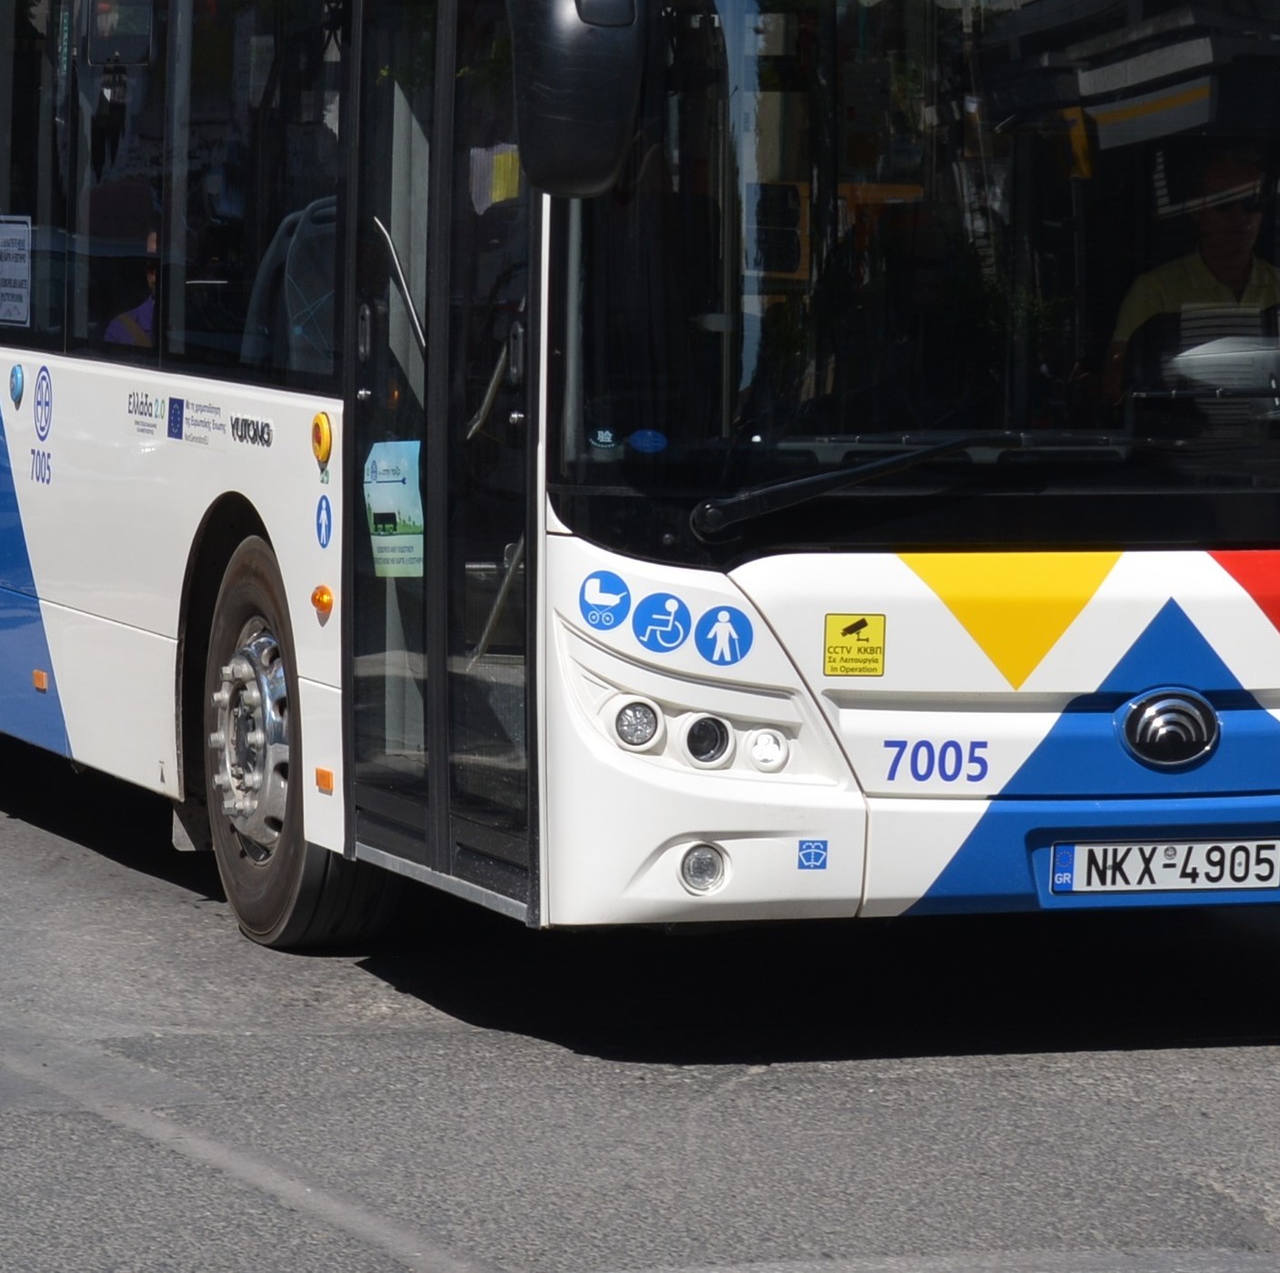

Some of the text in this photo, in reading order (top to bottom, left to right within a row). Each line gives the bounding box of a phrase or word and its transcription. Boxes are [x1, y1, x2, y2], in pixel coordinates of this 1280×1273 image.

[128, 391, 165, 419] Ελλάδα 2.0
[230, 415, 274, 448] YUTONG
[30, 448, 52, 486] 7005
[827, 646, 853, 655] CCTV
[828, 656, 837, 664] Σε
[839, 665, 878, 674] Operation
[884, 739, 990, 782] 7005
[1054, 872, 1072, 885] GR
